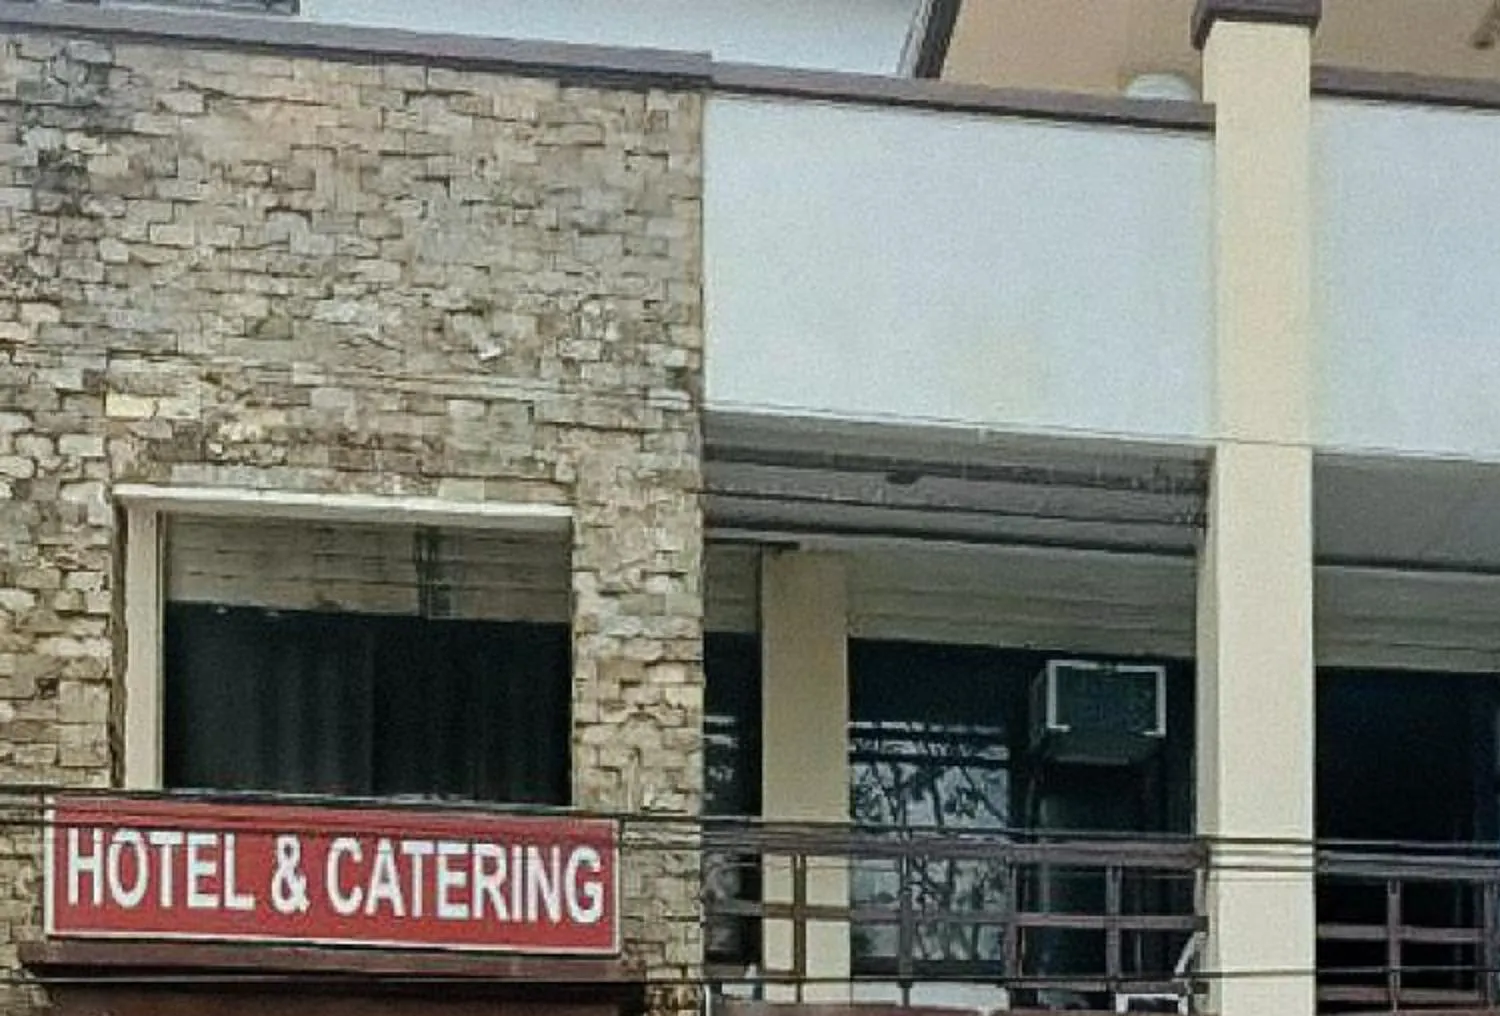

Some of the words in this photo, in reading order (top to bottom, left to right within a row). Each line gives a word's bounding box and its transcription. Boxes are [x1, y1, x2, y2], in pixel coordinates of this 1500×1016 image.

[67, 827, 256, 911] HOTEL
[271, 834, 311, 914] &
[326, 836, 604, 924] CATERING
